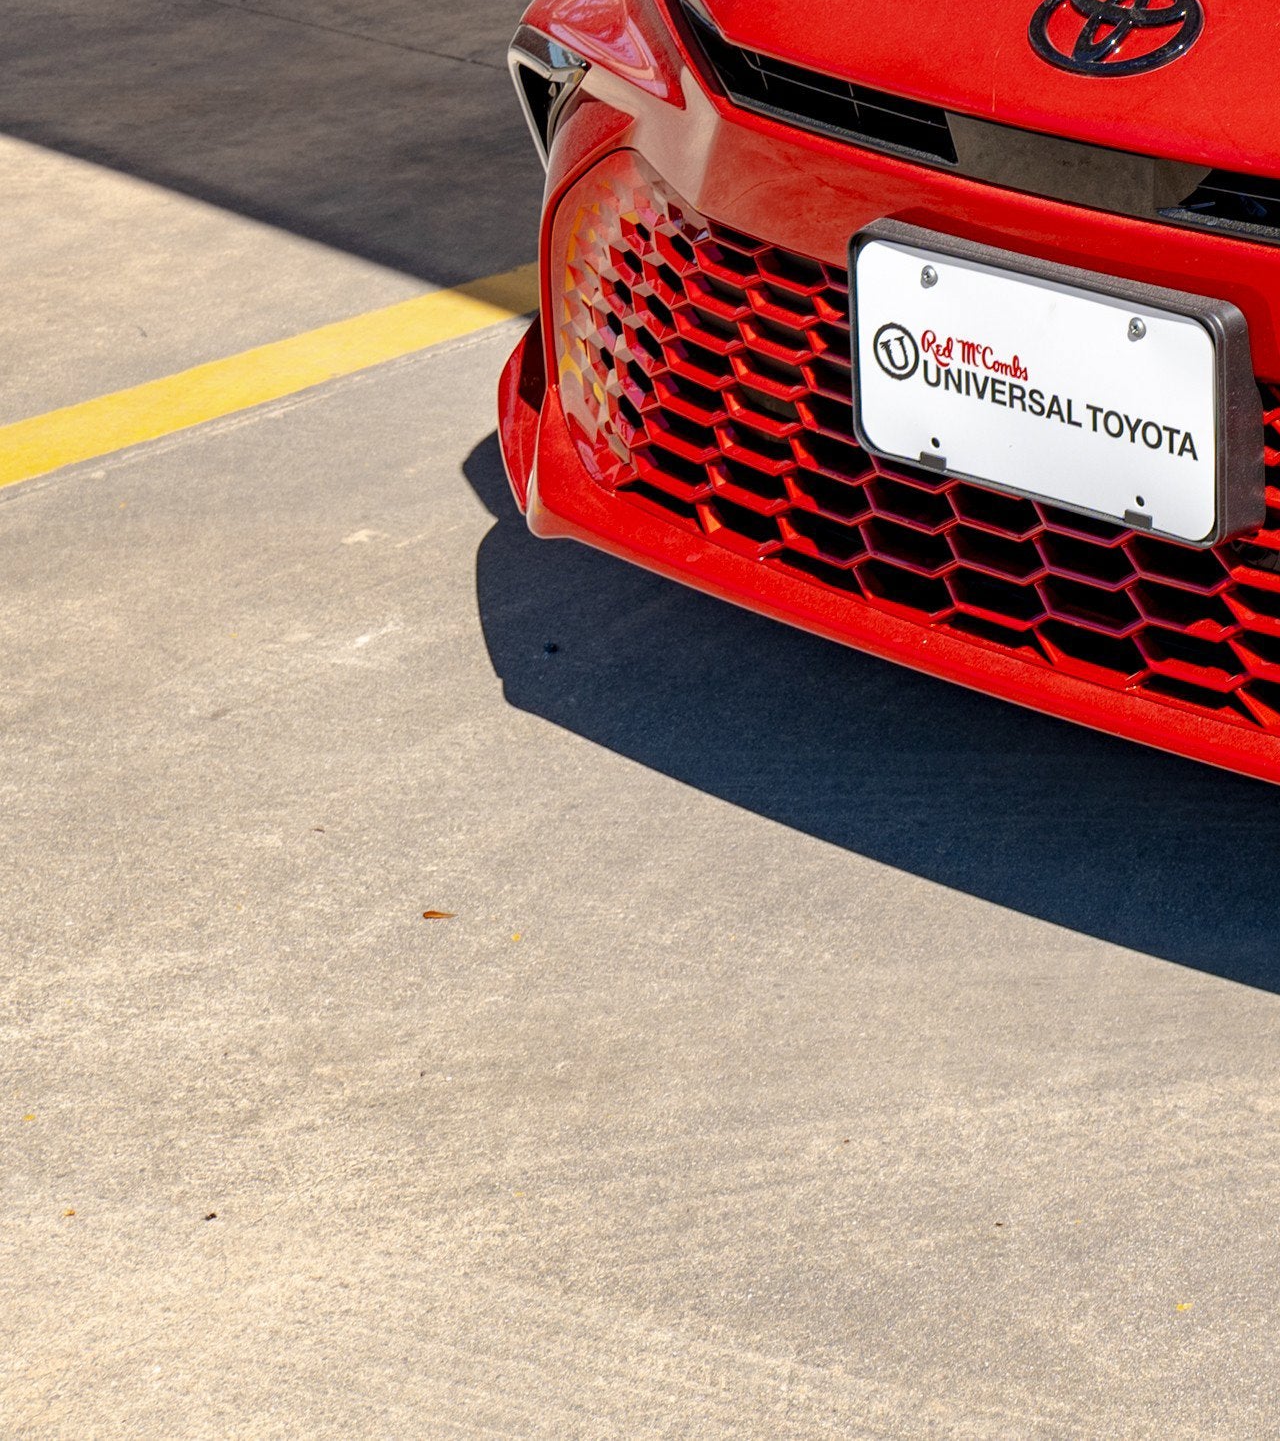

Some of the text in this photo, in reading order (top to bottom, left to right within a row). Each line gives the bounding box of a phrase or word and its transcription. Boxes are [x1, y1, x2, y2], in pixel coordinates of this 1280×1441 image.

[921, 330, 1028, 381] Red McCombs
[923, 359, 1199, 461] UNIVERSAL TOYOTA
